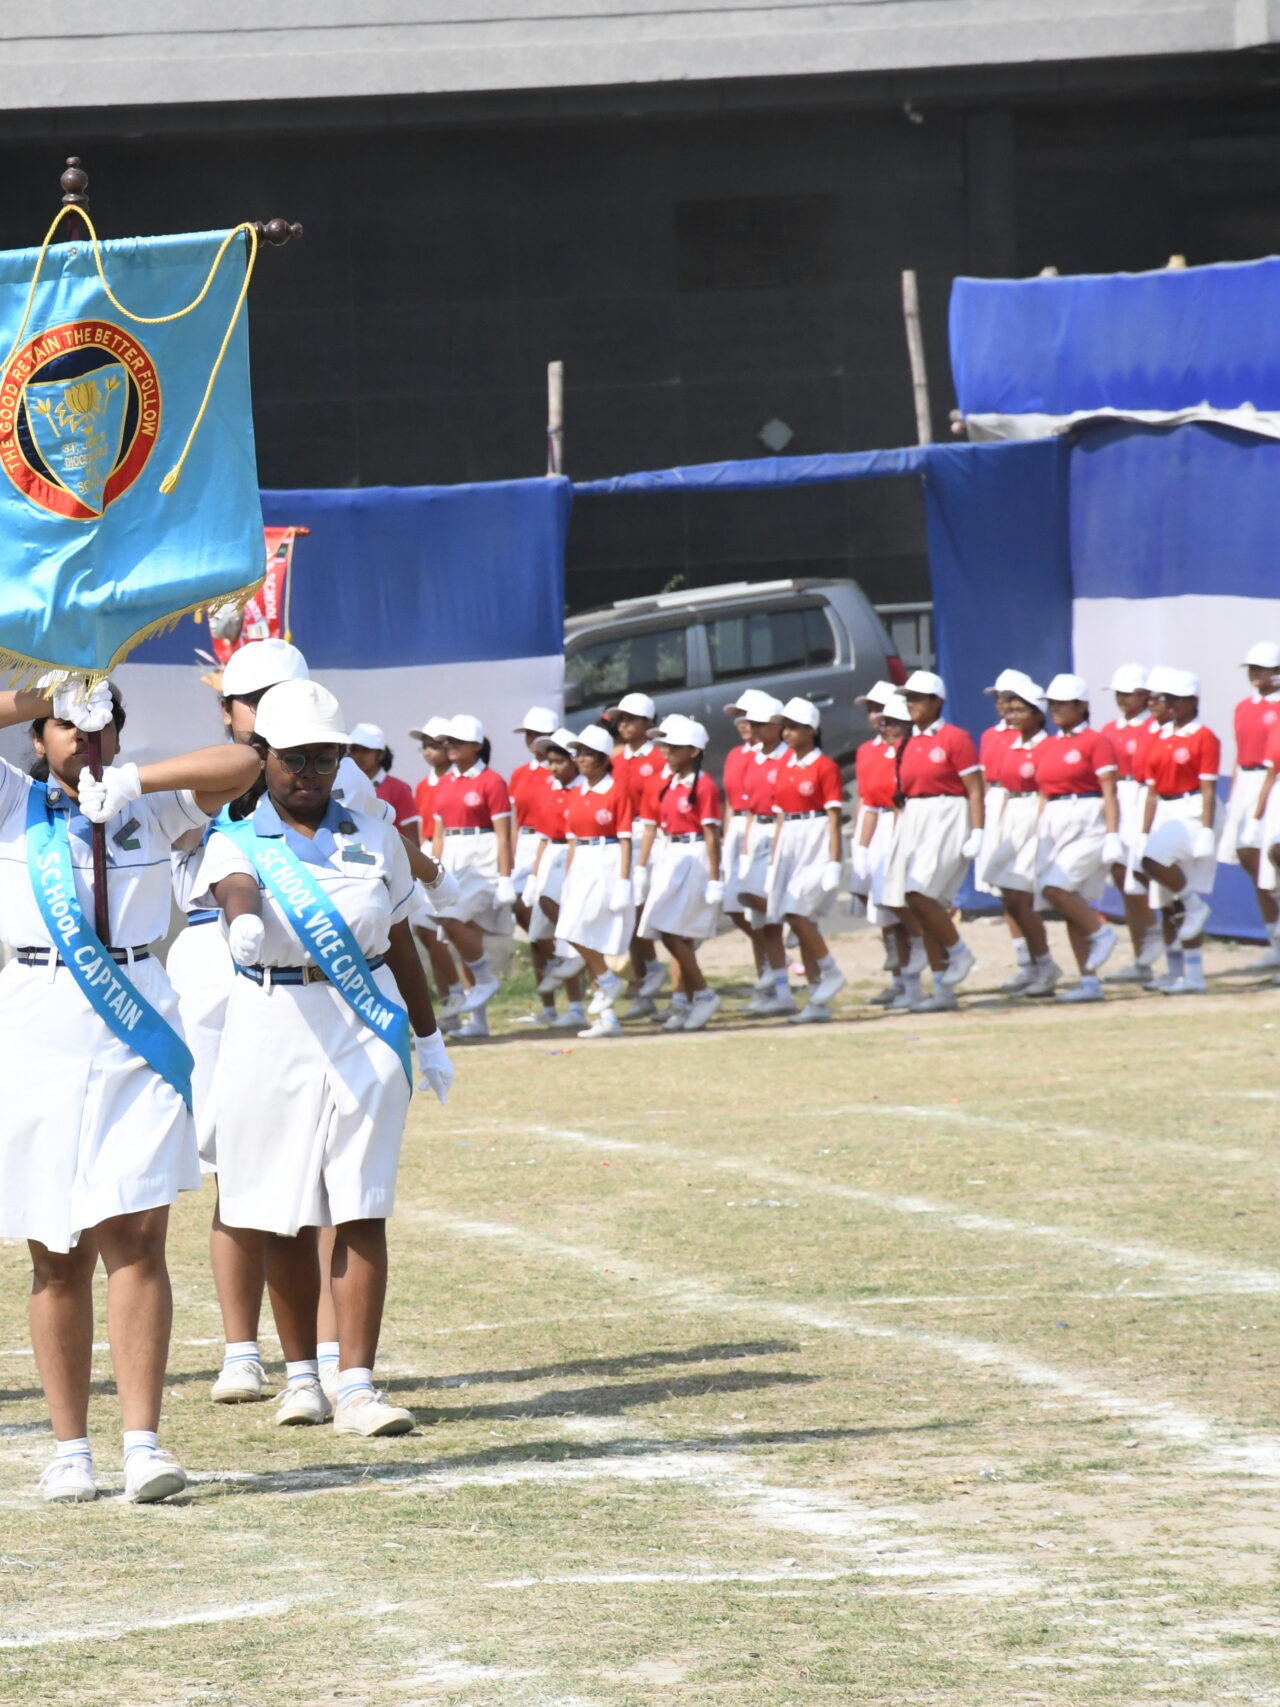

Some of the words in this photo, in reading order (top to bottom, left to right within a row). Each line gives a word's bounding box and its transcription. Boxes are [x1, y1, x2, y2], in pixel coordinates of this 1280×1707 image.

[11, 335, 62, 381] RETAIN
[62, 327, 92, 346] THE
[94, 327, 146, 372] BETTER
[0, 383, 19, 433] GOOD
[138, 369, 158, 437] FOLLOW
[1, 438, 20, 473] THE
[36, 851, 80, 948] SCHOOL
[73, 944, 144, 1033] CAPTAIN
[255, 847, 317, 918] SCHOOL
[303, 909, 346, 959] VICE
[330, 954, 394, 1032] CAPTAIN
